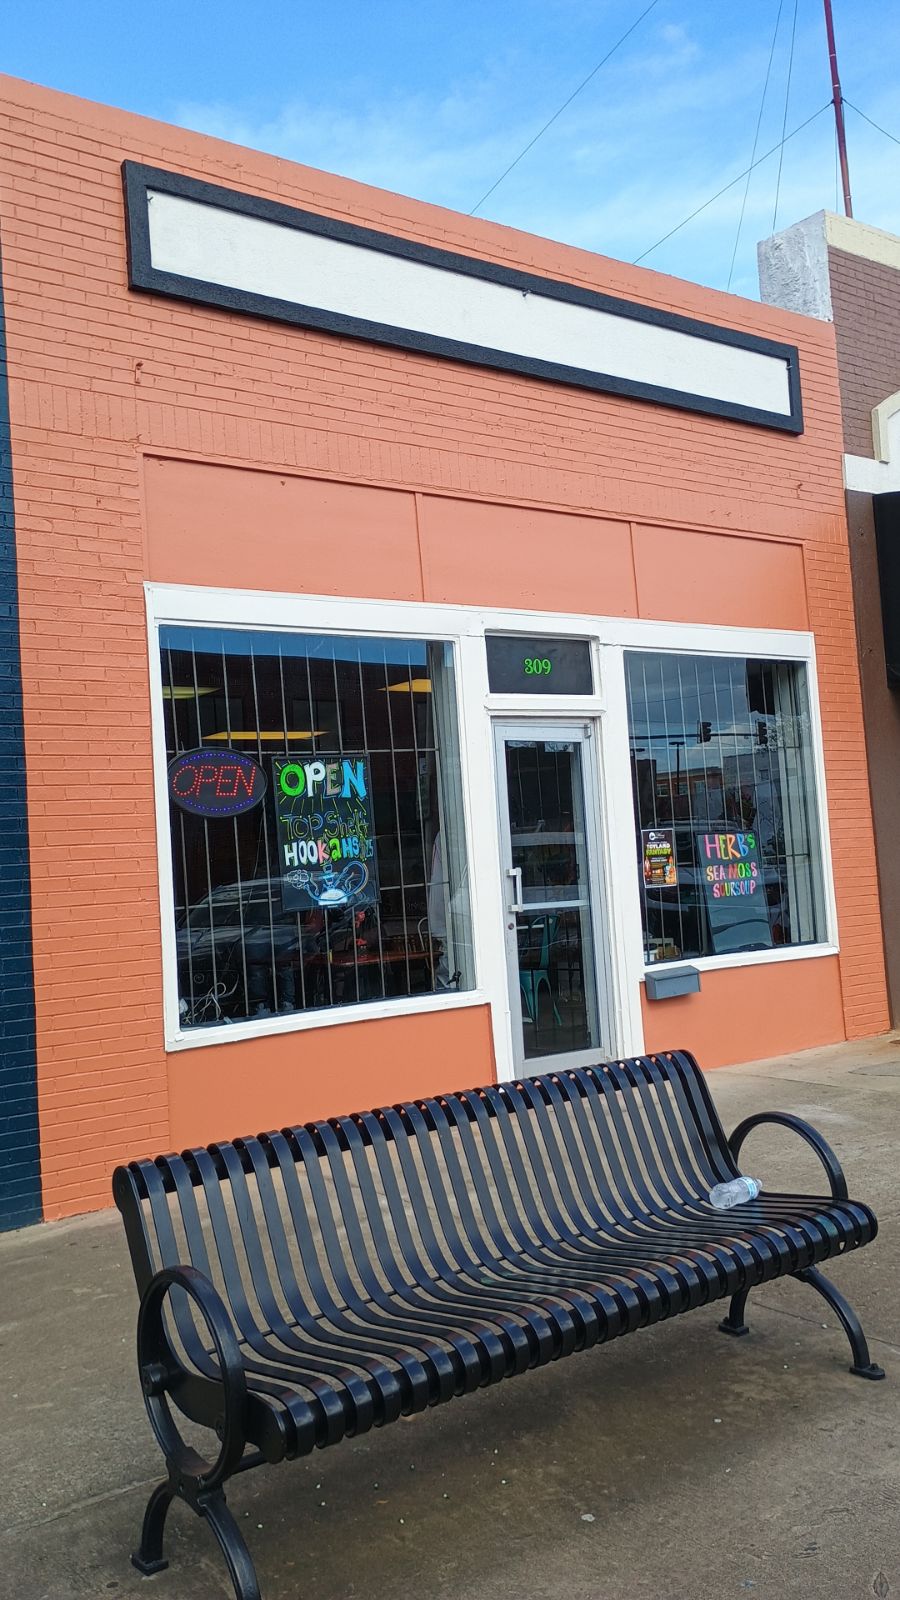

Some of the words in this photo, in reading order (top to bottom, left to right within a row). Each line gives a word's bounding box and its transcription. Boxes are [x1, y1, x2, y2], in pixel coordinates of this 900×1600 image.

[524, 658, 552, 675] 309
[172, 765, 257, 799] OPEN
[279, 759, 367, 800] OPEN
[706, 865, 726, 882] SEA
[728, 861, 758, 880] MOSS
